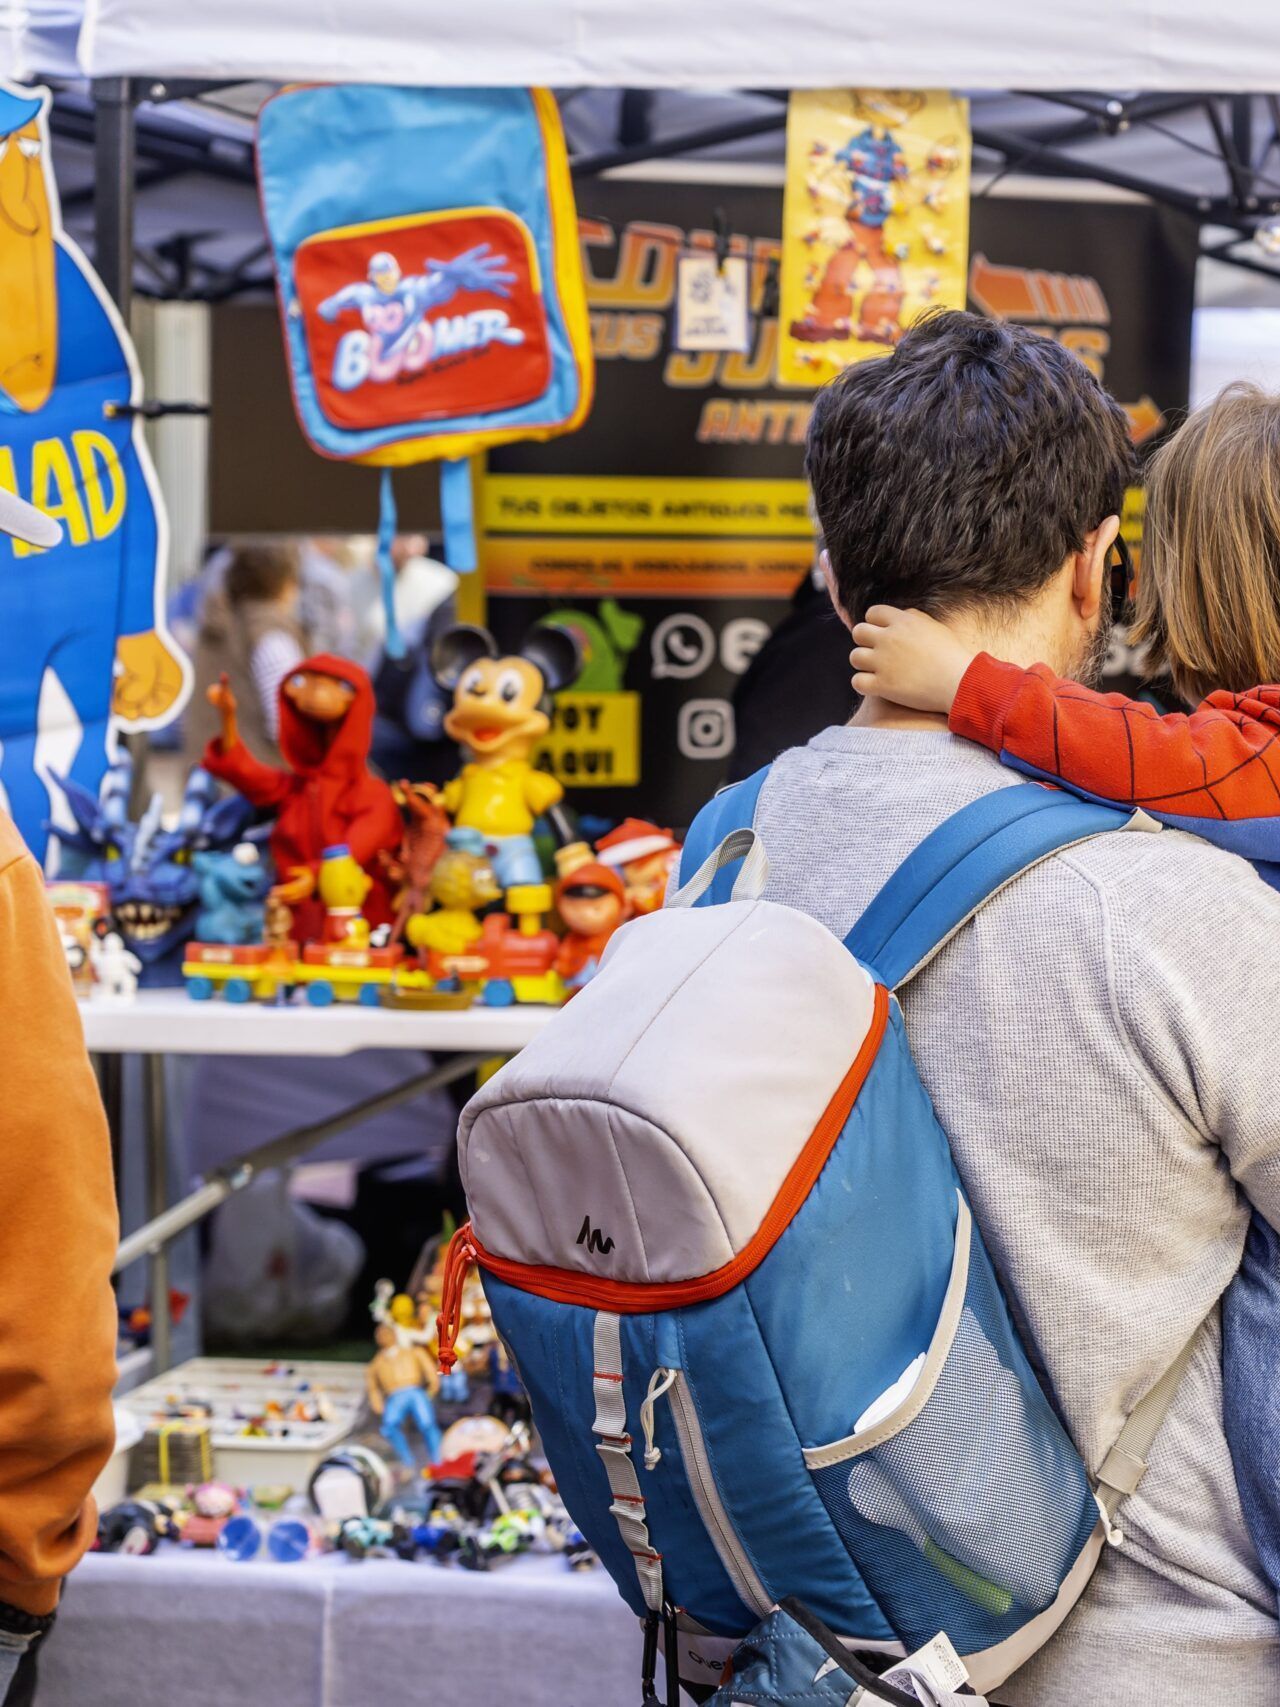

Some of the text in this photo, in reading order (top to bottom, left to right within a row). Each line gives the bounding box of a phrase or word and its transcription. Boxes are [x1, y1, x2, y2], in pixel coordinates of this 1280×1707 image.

[332, 309, 524, 391] BOOMER
[590, 312, 665, 361] US
[0, 429, 127, 558] AD
